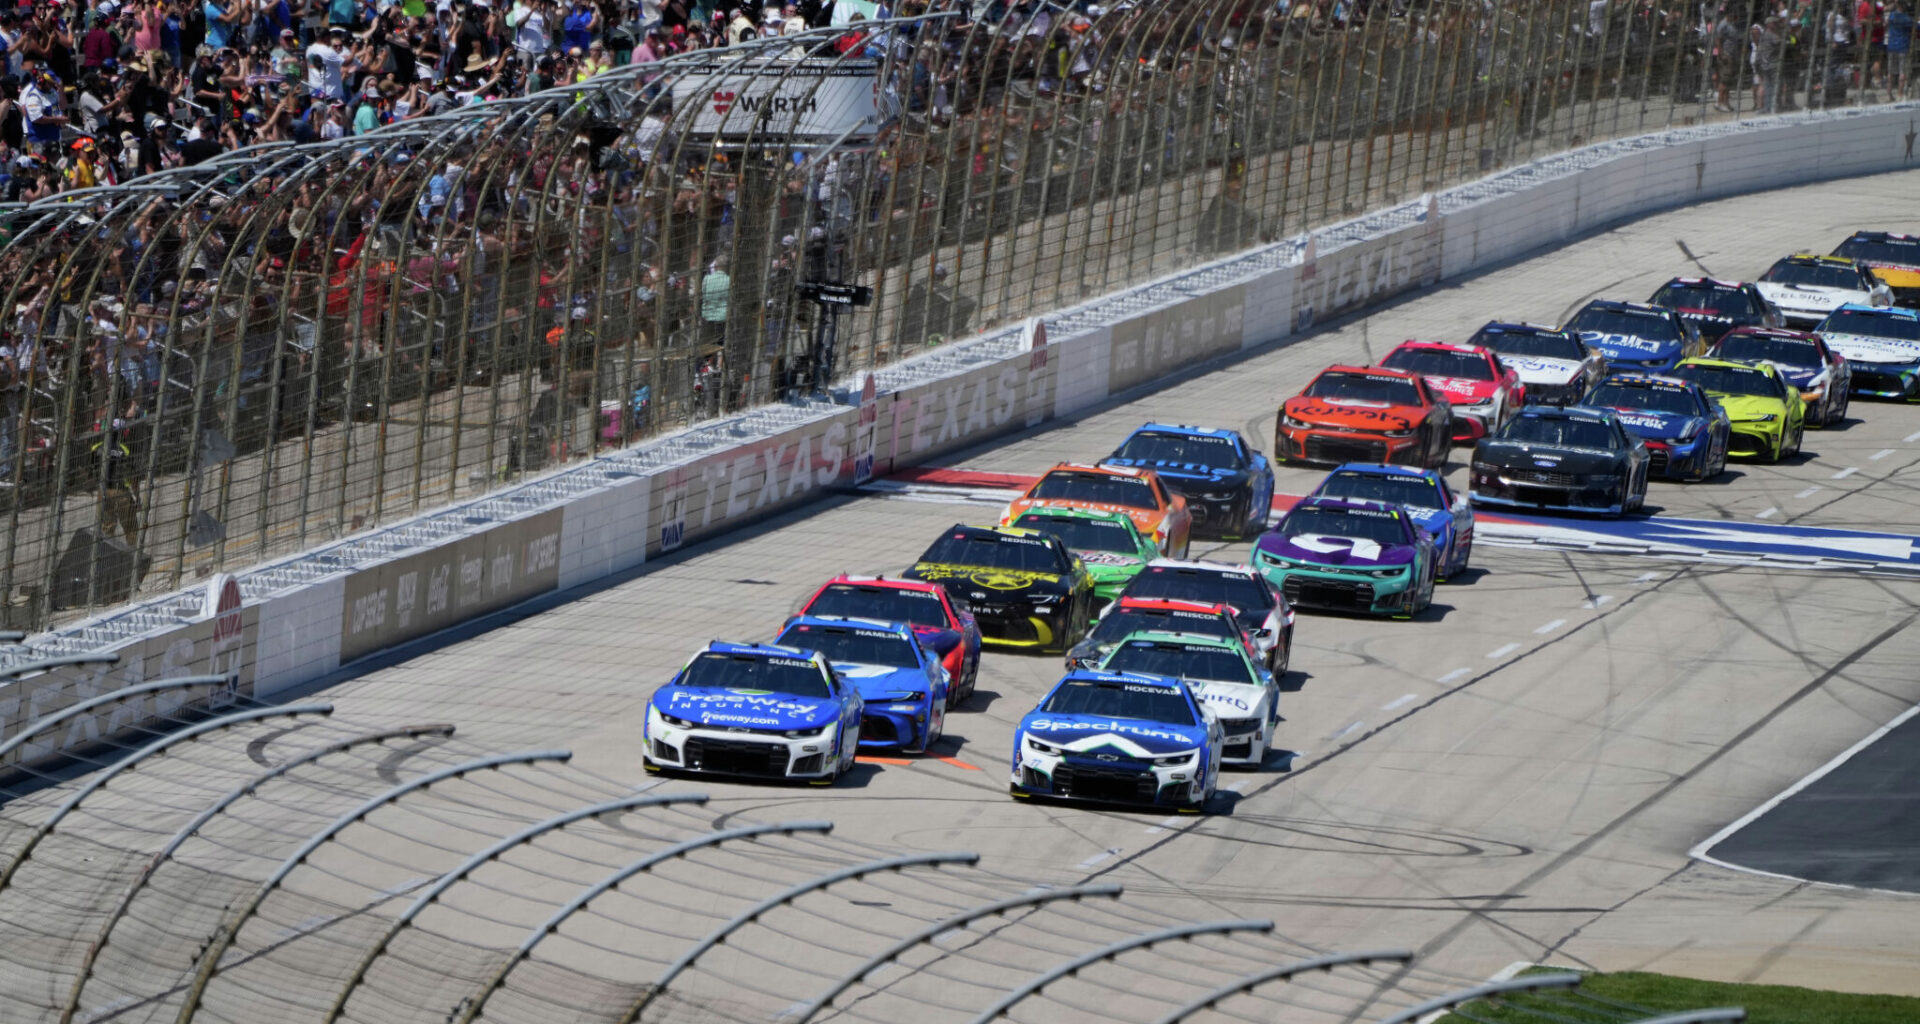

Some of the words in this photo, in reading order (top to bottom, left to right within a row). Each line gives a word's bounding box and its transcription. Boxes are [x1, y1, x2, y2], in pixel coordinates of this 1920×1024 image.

[1320, 241, 1413, 312] TEXAS
[1771, 292, 1830, 303] CELSIUS
[888, 366, 1019, 458] TEXAS
[1292, 406, 1410, 429] Kubota
[1188, 436, 1225, 444] ELLIOTT
[702, 422, 846, 528] TEXAS
[1387, 475, 1424, 483] LARSON
[1348, 509, 1391, 518] BOWMAN
[1001, 537, 1041, 545] REDDICK
[1222, 572, 1249, 580] BELL
[899, 590, 936, 599] BUSCH
[1173, 611, 1219, 621] BRISCOE
[855, 629, 900, 640] HAMLIN
[768, 657, 816, 667] SUÁREZ
[670, 703, 816, 722] INSURANCE
[701, 711, 779, 725] Freeway.com
[1030, 719, 1190, 743] Spectrum
